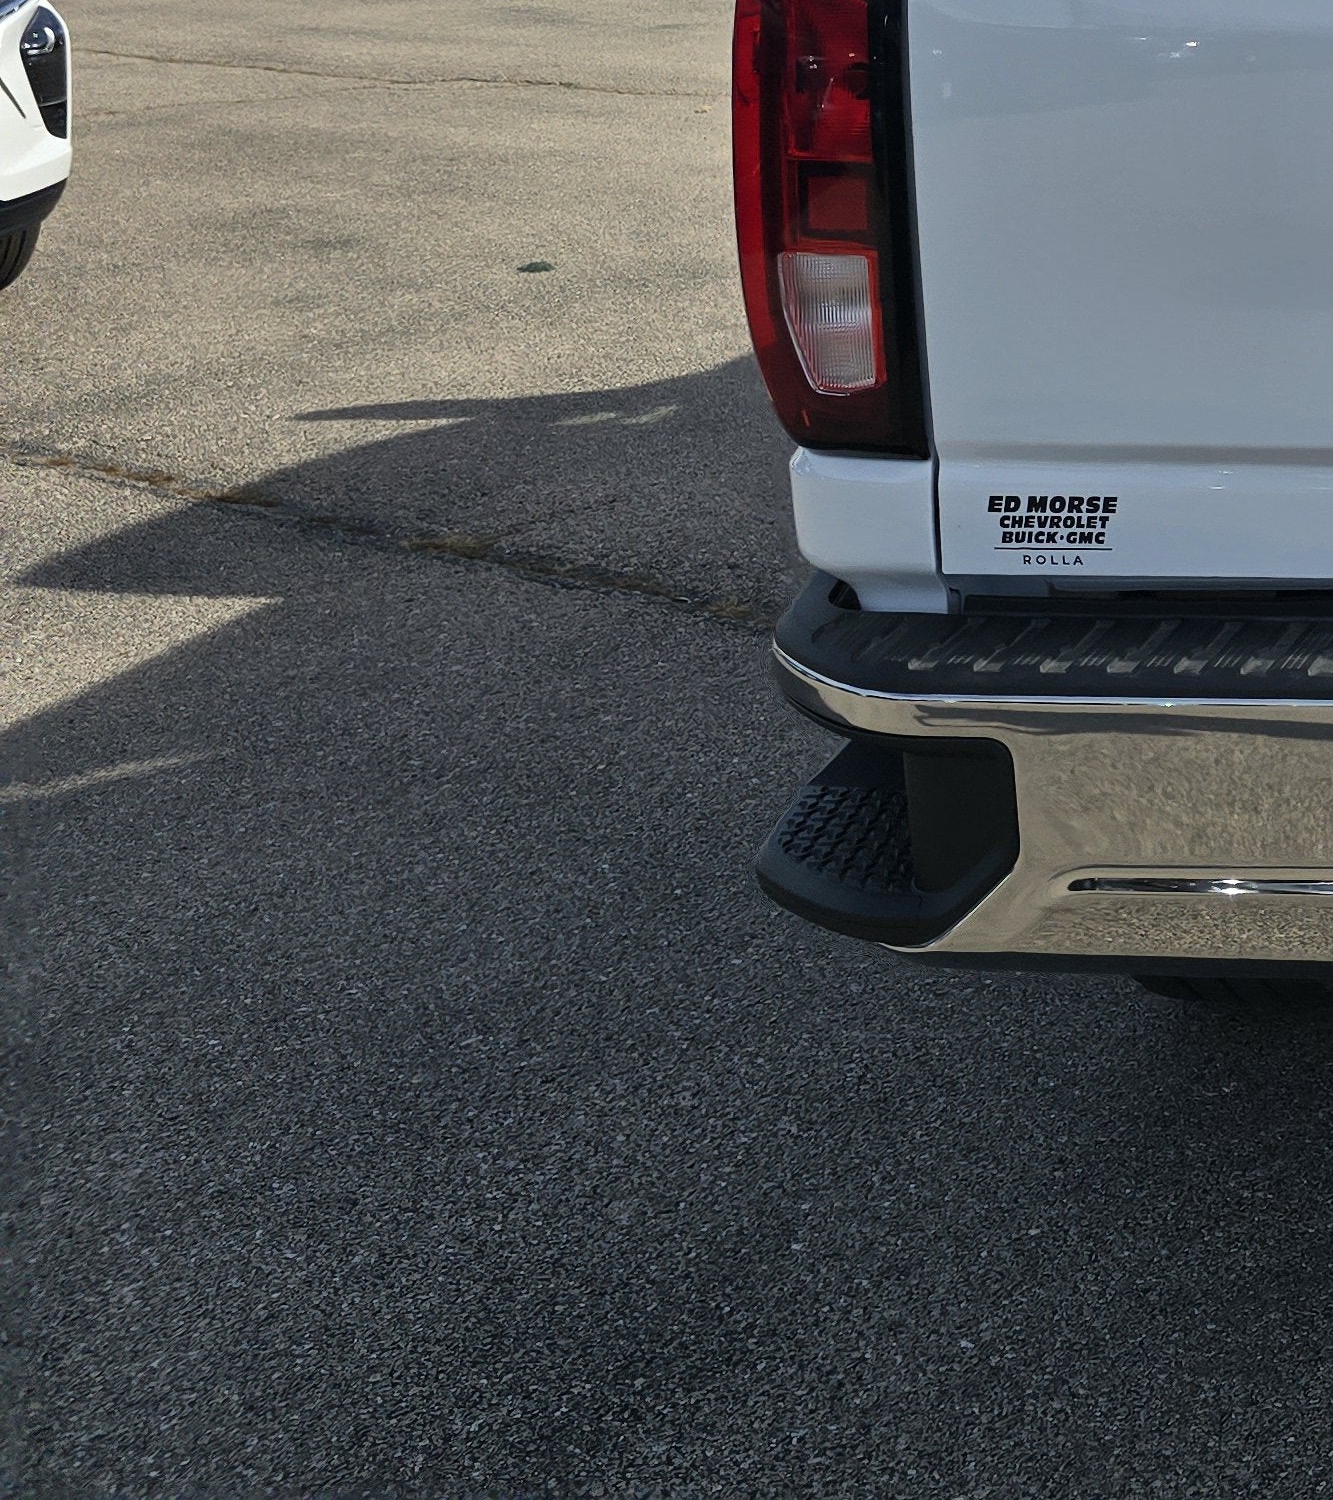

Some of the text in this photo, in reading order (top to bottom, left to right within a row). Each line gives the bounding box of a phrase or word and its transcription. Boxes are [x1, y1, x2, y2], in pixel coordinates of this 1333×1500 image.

[988, 495, 1118, 513] ED MORSE
[999, 515, 1110, 529] CHEVROLET
[1023, 555, 1084, 565] ROLLA
